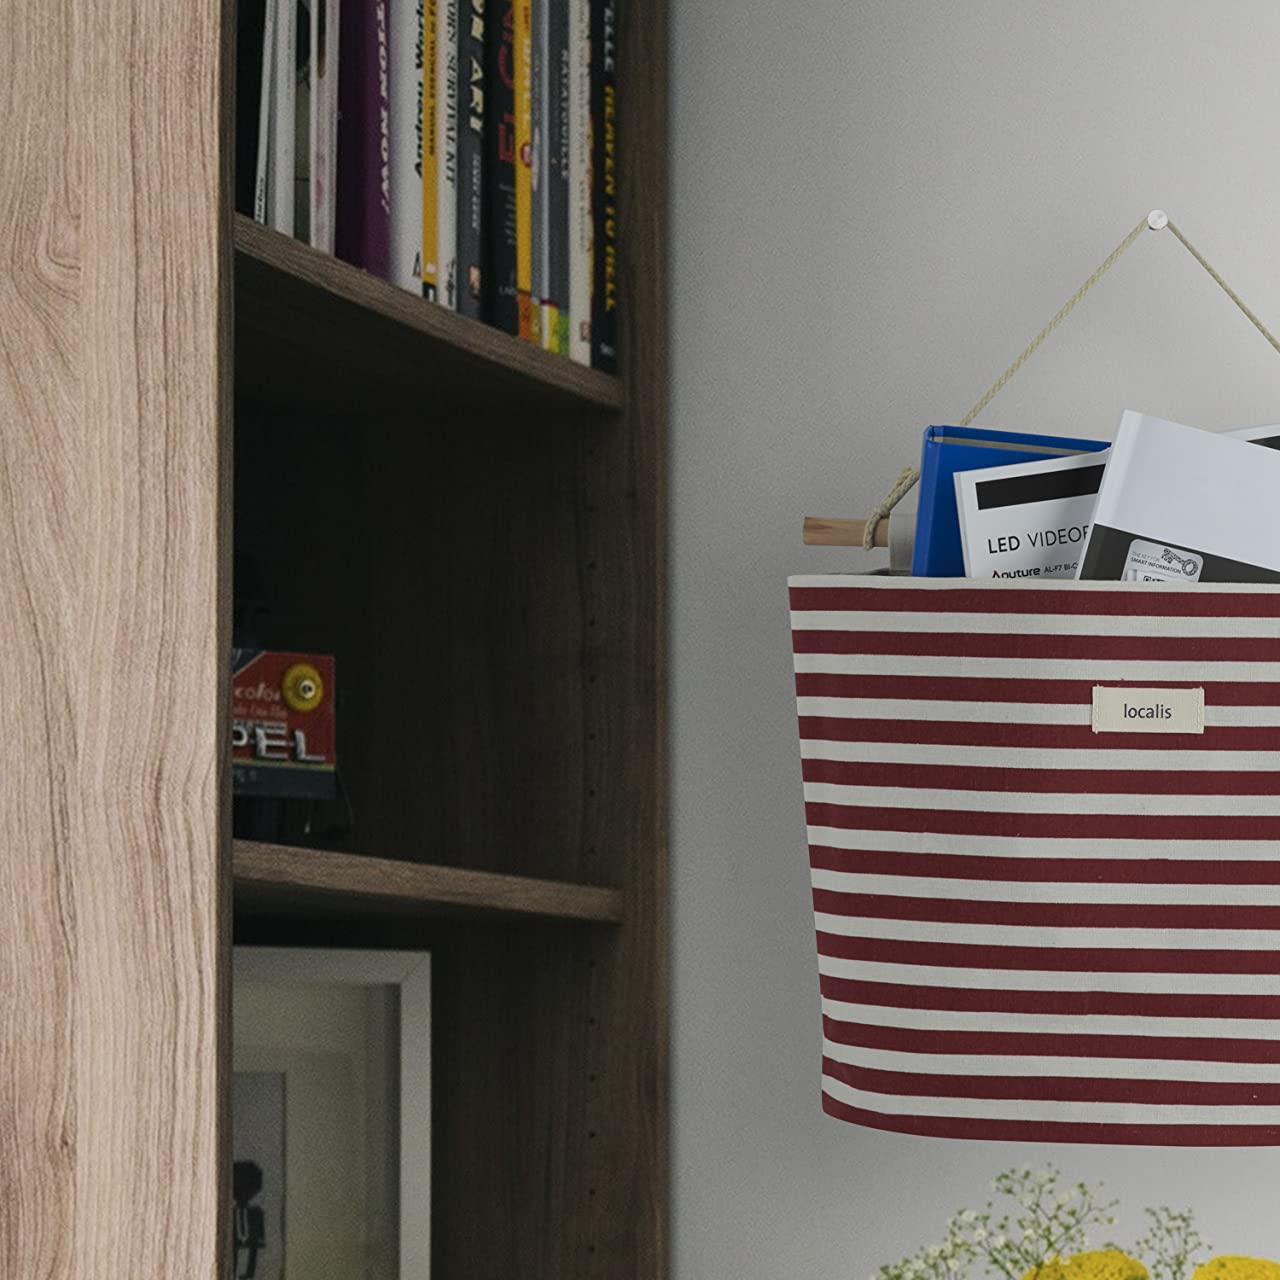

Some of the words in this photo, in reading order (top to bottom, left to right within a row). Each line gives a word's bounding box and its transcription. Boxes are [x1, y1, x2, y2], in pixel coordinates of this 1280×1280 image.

[376, 0, 389, 98] TION
[603, 0, 616, 72] ELLE
[446, 54, 458, 146] SURVIVAL
[469, 56, 485, 133] ART
[380, 107, 391, 215] NOW!
[446, 151, 458, 187] KIT
[988, 536, 1020, 554] LED
[1131, 557, 1148, 566] SMART
[1148, 561, 1182, 574] INFORMATION
[1124, 703, 1172, 719] localis
